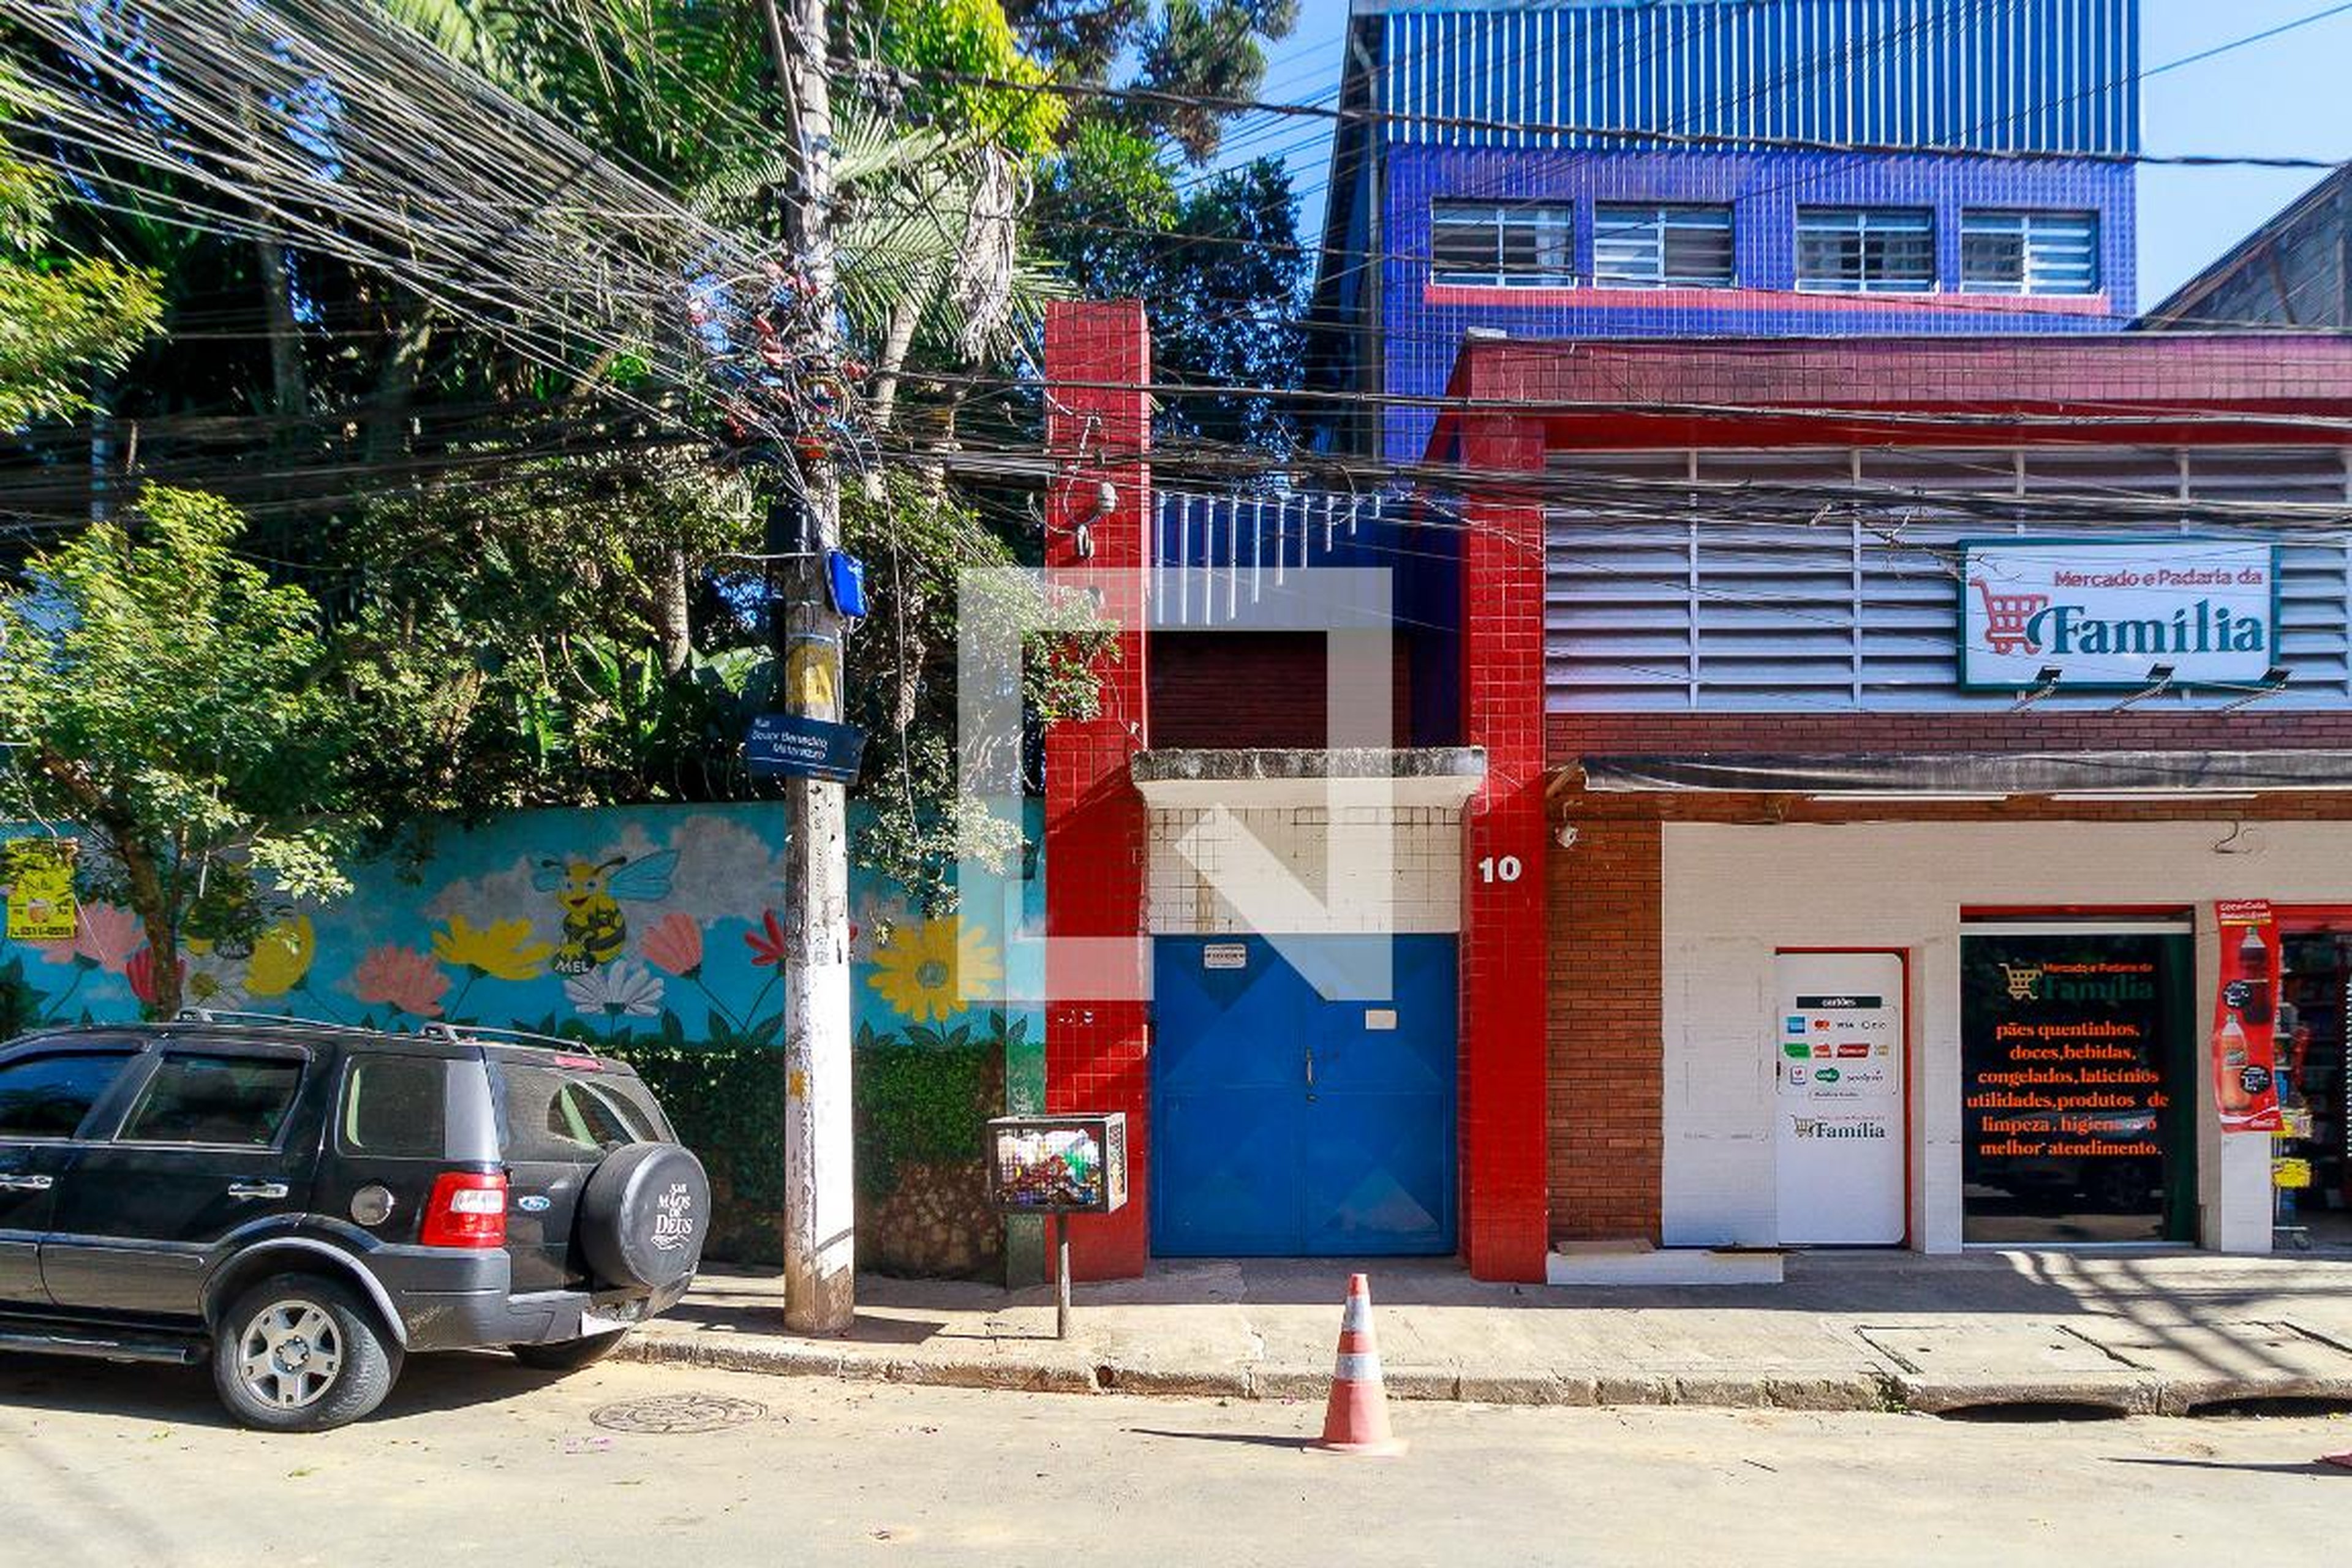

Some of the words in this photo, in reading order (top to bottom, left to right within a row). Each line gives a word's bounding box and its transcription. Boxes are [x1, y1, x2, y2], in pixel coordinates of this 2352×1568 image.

[2054, 569, 2139, 587] Mercado
[2143, 573, 2156, 586] e
[2158, 568, 2232, 585] Padaria
[2237, 568, 2263, 584] da
[2027, 598, 2264, 654] Família
[1478, 856, 1522, 883] 10
[554, 959, 589, 973] MEL
[1996, 1021, 2034, 1040] pães
[2038, 1020, 2140, 1040] quentinhos,
[1977, 1067, 2078, 1087] congelados,
[2147, 1092, 2169, 1107] de
[1808, 1122, 1885, 1138] Família
[1980, 1138, 2042, 1155] melhor
[2048, 1138, 2163, 1155] atendimento.
